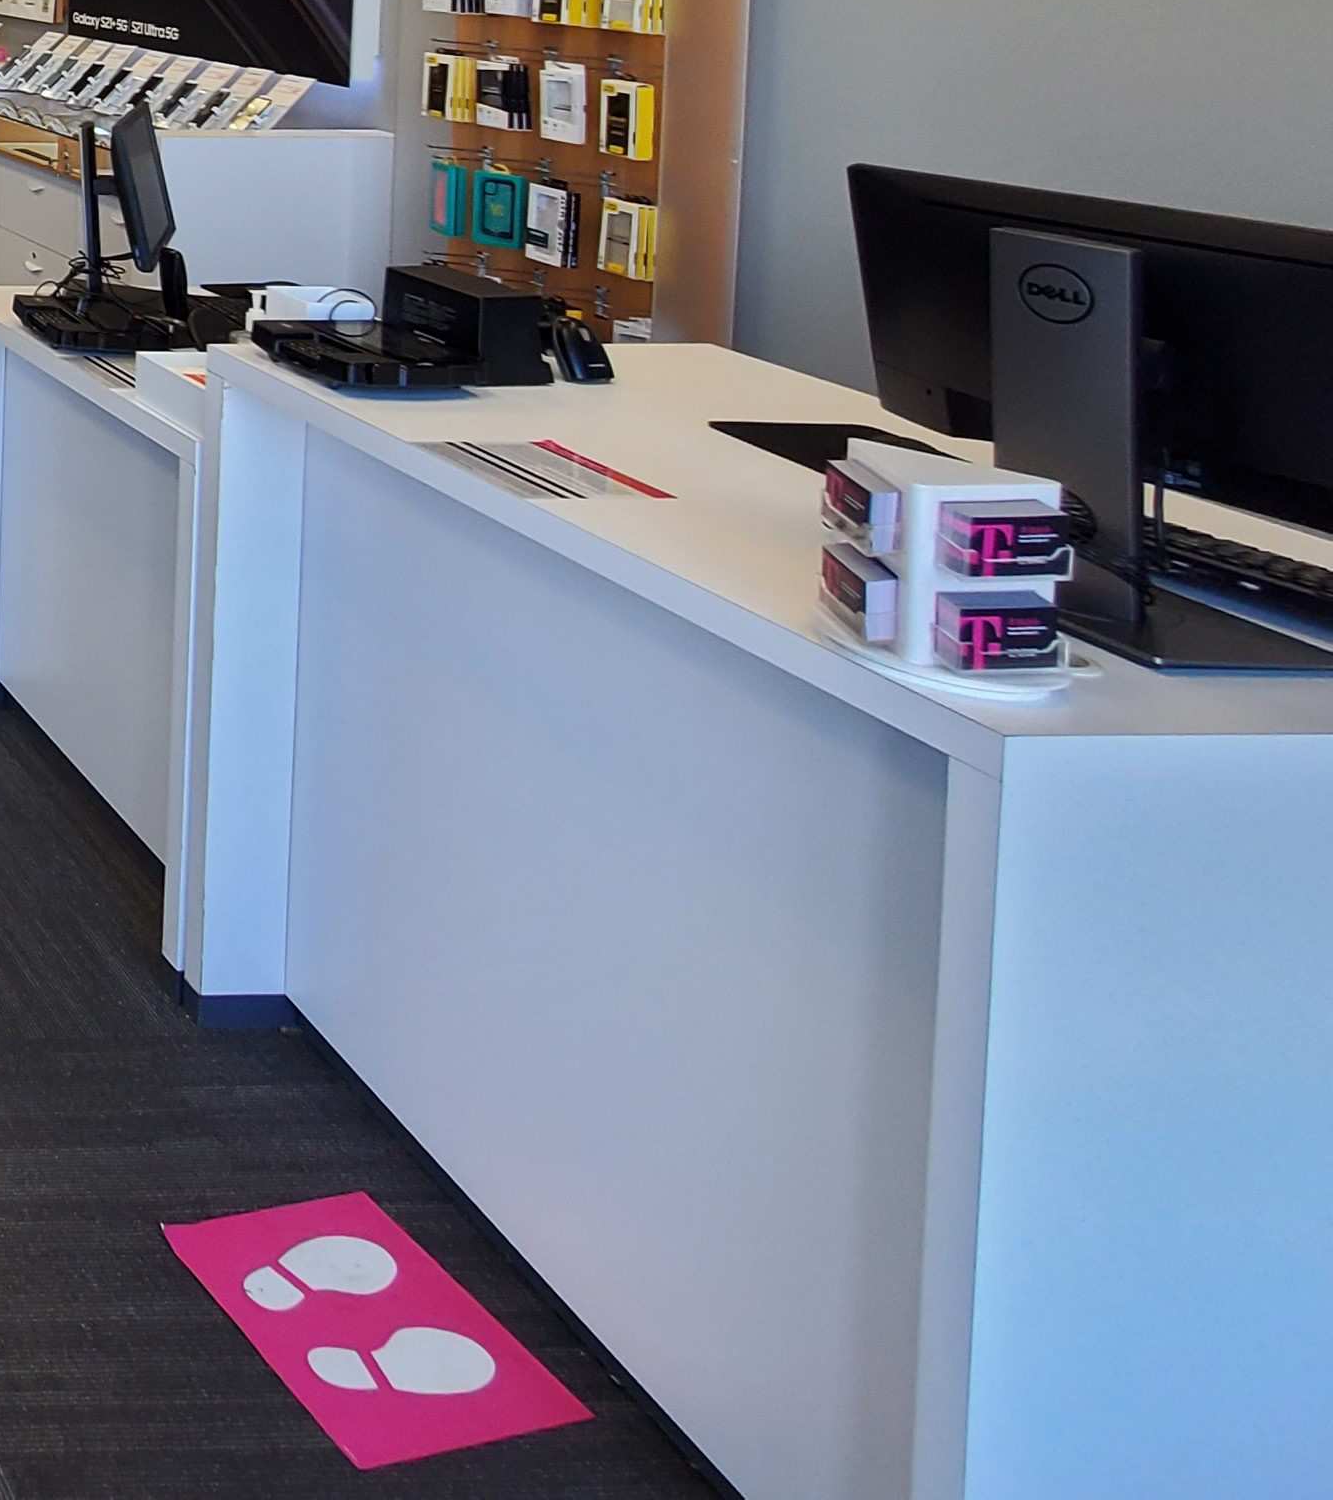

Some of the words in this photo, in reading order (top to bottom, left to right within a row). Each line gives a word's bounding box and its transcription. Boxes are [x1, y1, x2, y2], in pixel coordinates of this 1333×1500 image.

[72, 11, 101, 30] Galaxy
[165, 26, 180, 40] 5G
[1026, 281, 1087, 306] DELL
